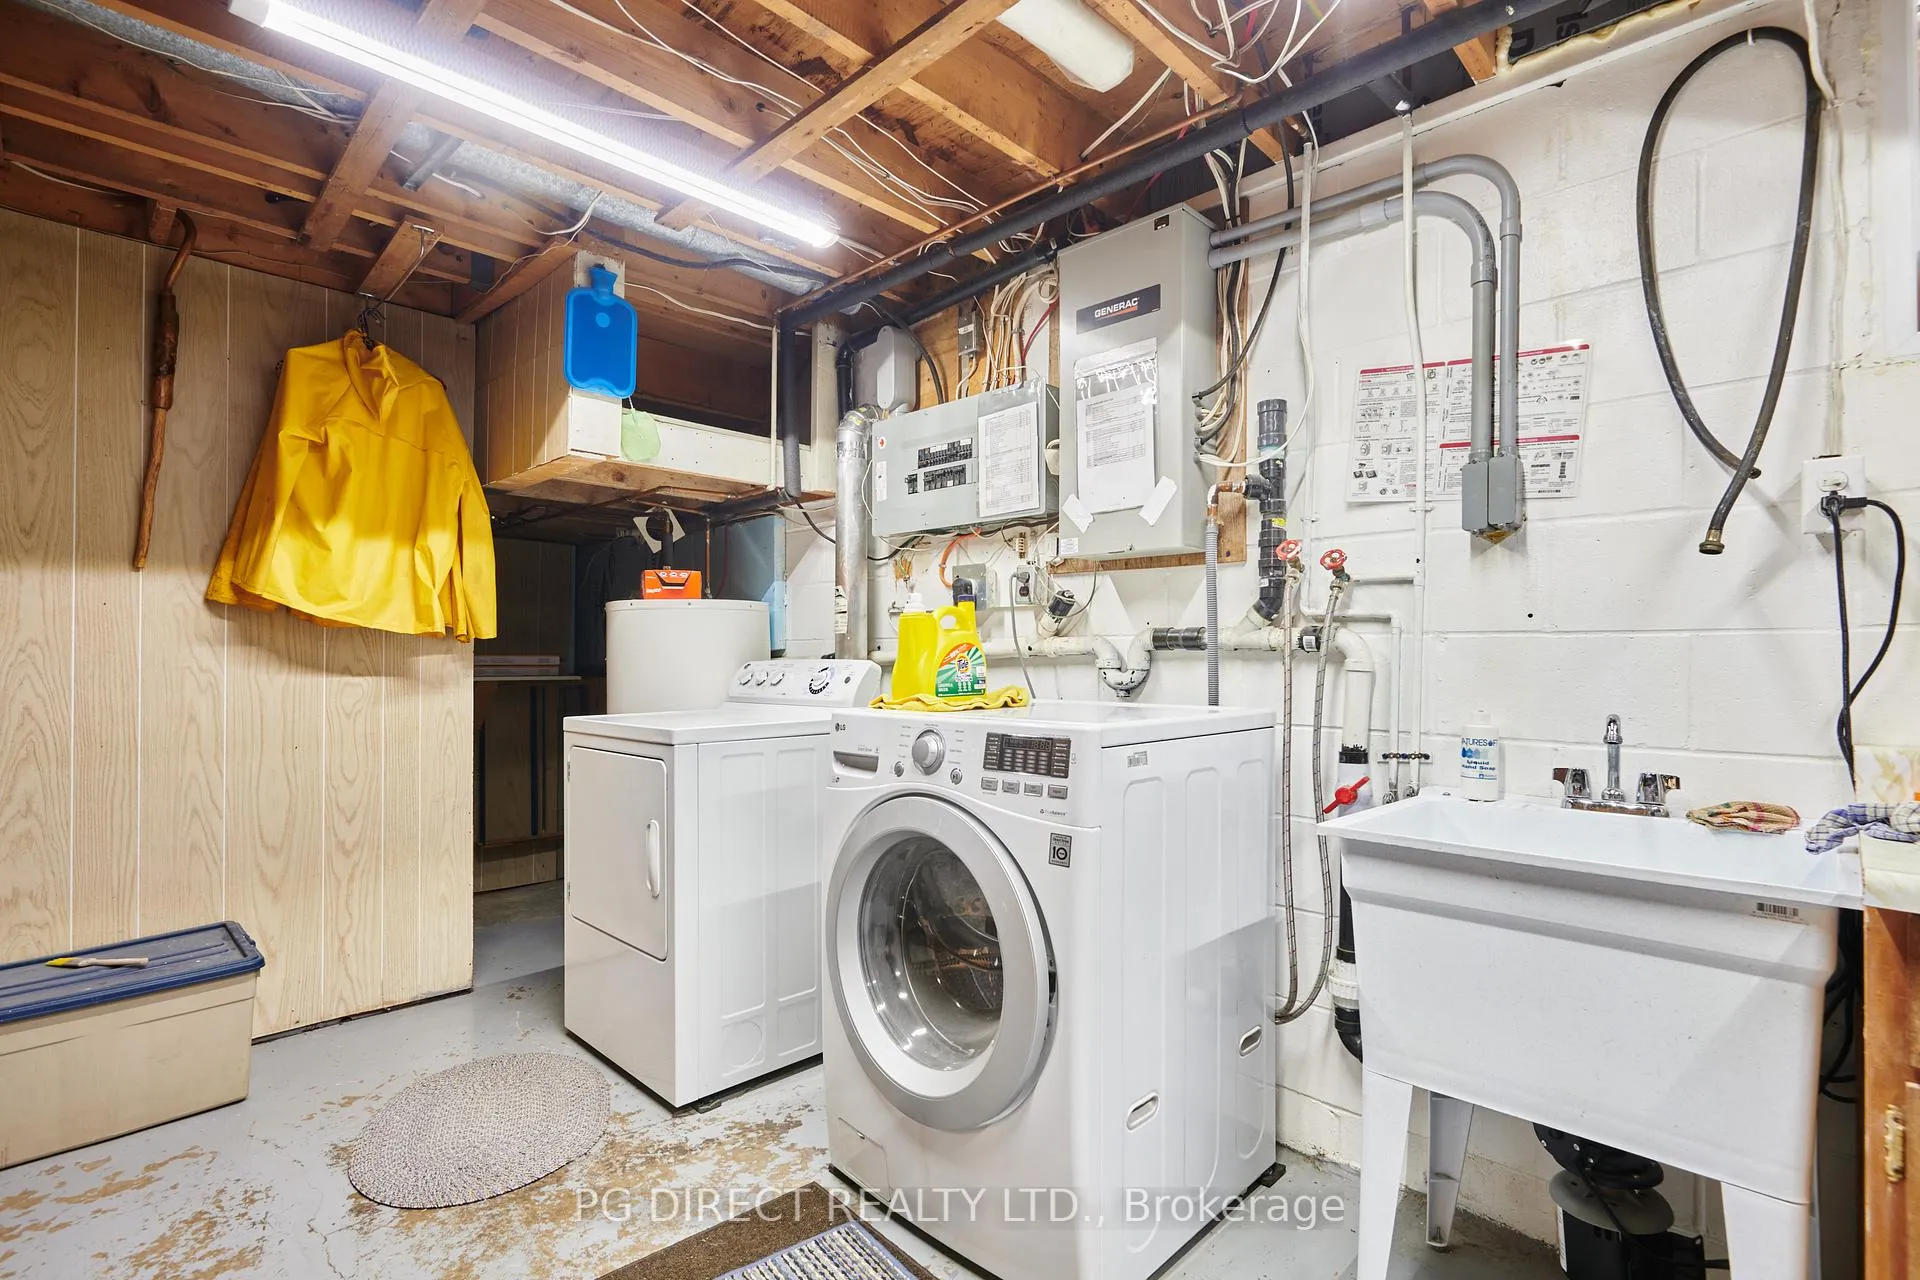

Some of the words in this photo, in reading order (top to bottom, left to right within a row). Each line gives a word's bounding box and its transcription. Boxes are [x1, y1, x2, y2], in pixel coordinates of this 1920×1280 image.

[1094, 297, 1139, 318] GENERAC
[957, 659, 969, 670] Tide
[1053, 846, 1068, 860] 10
